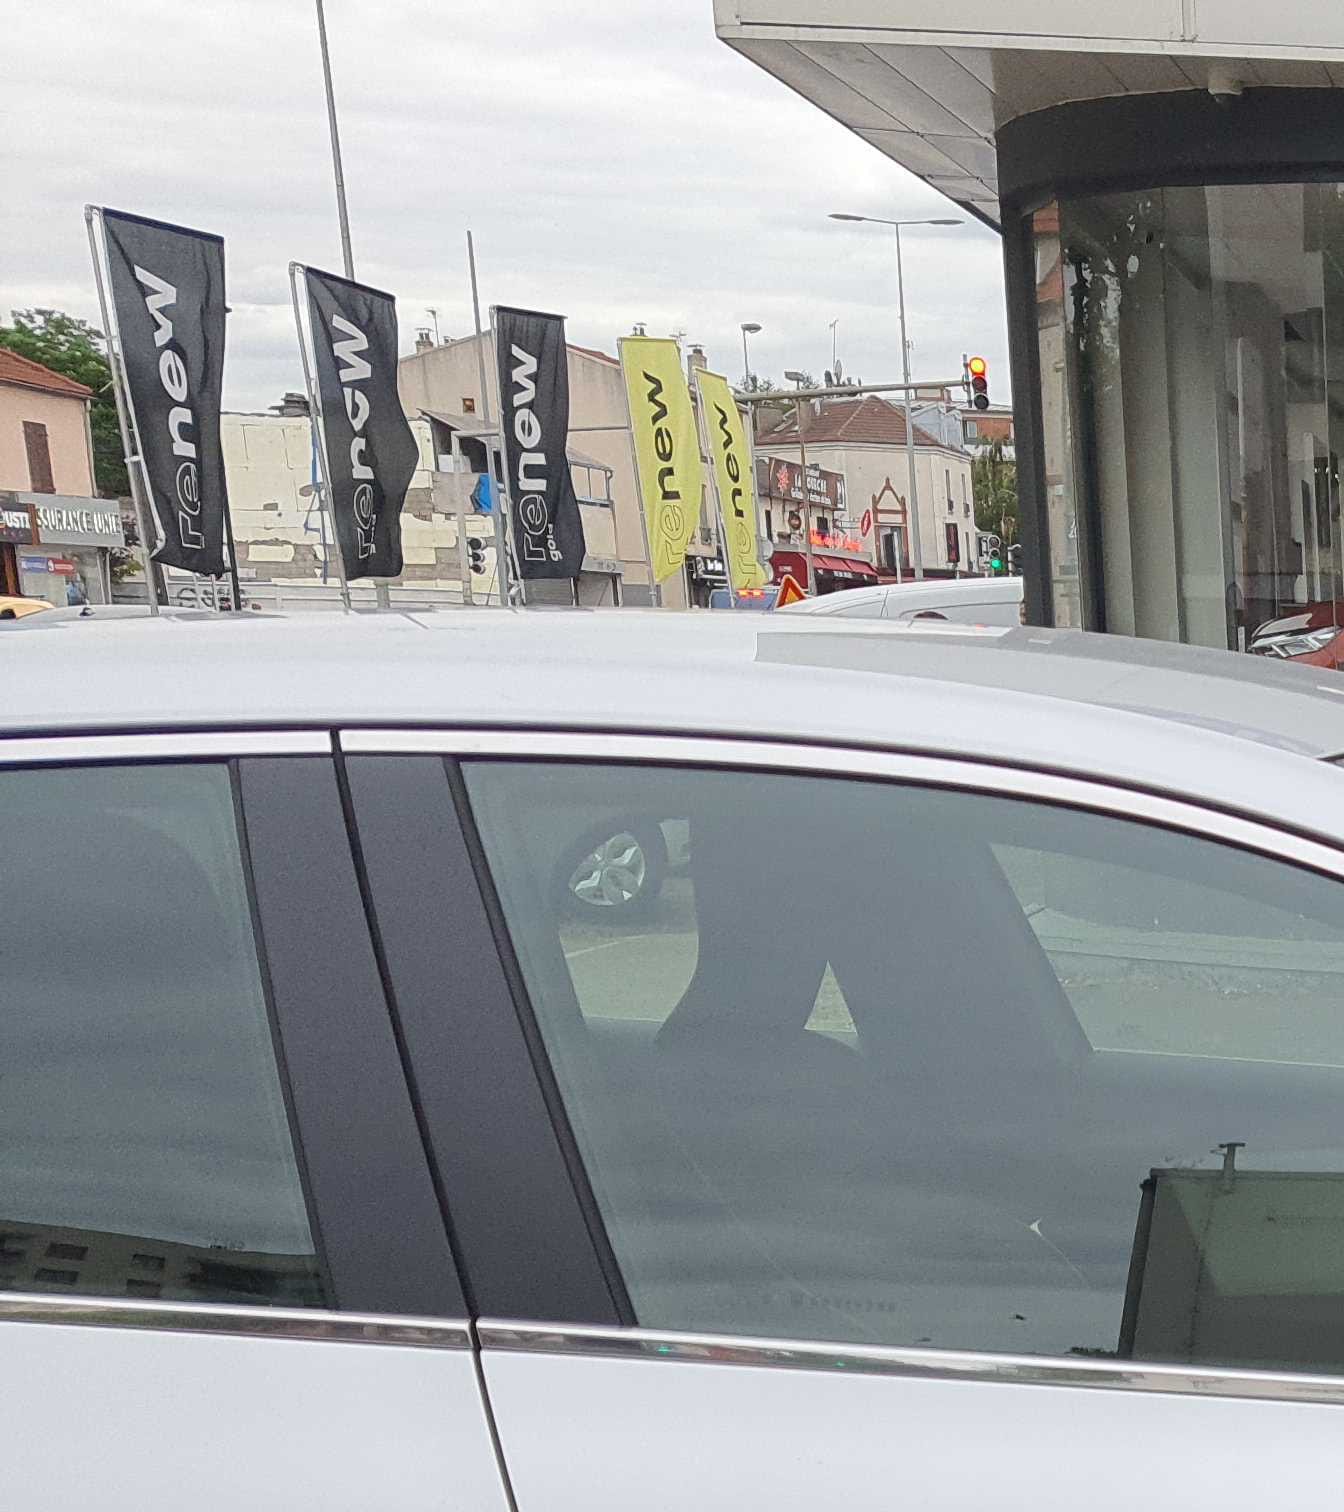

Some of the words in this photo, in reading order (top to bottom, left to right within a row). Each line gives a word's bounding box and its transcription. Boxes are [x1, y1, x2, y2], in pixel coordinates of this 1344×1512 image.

[134, 263, 205, 550] renew
[511, 343, 548, 561] renew
[642, 370, 688, 565] renew
